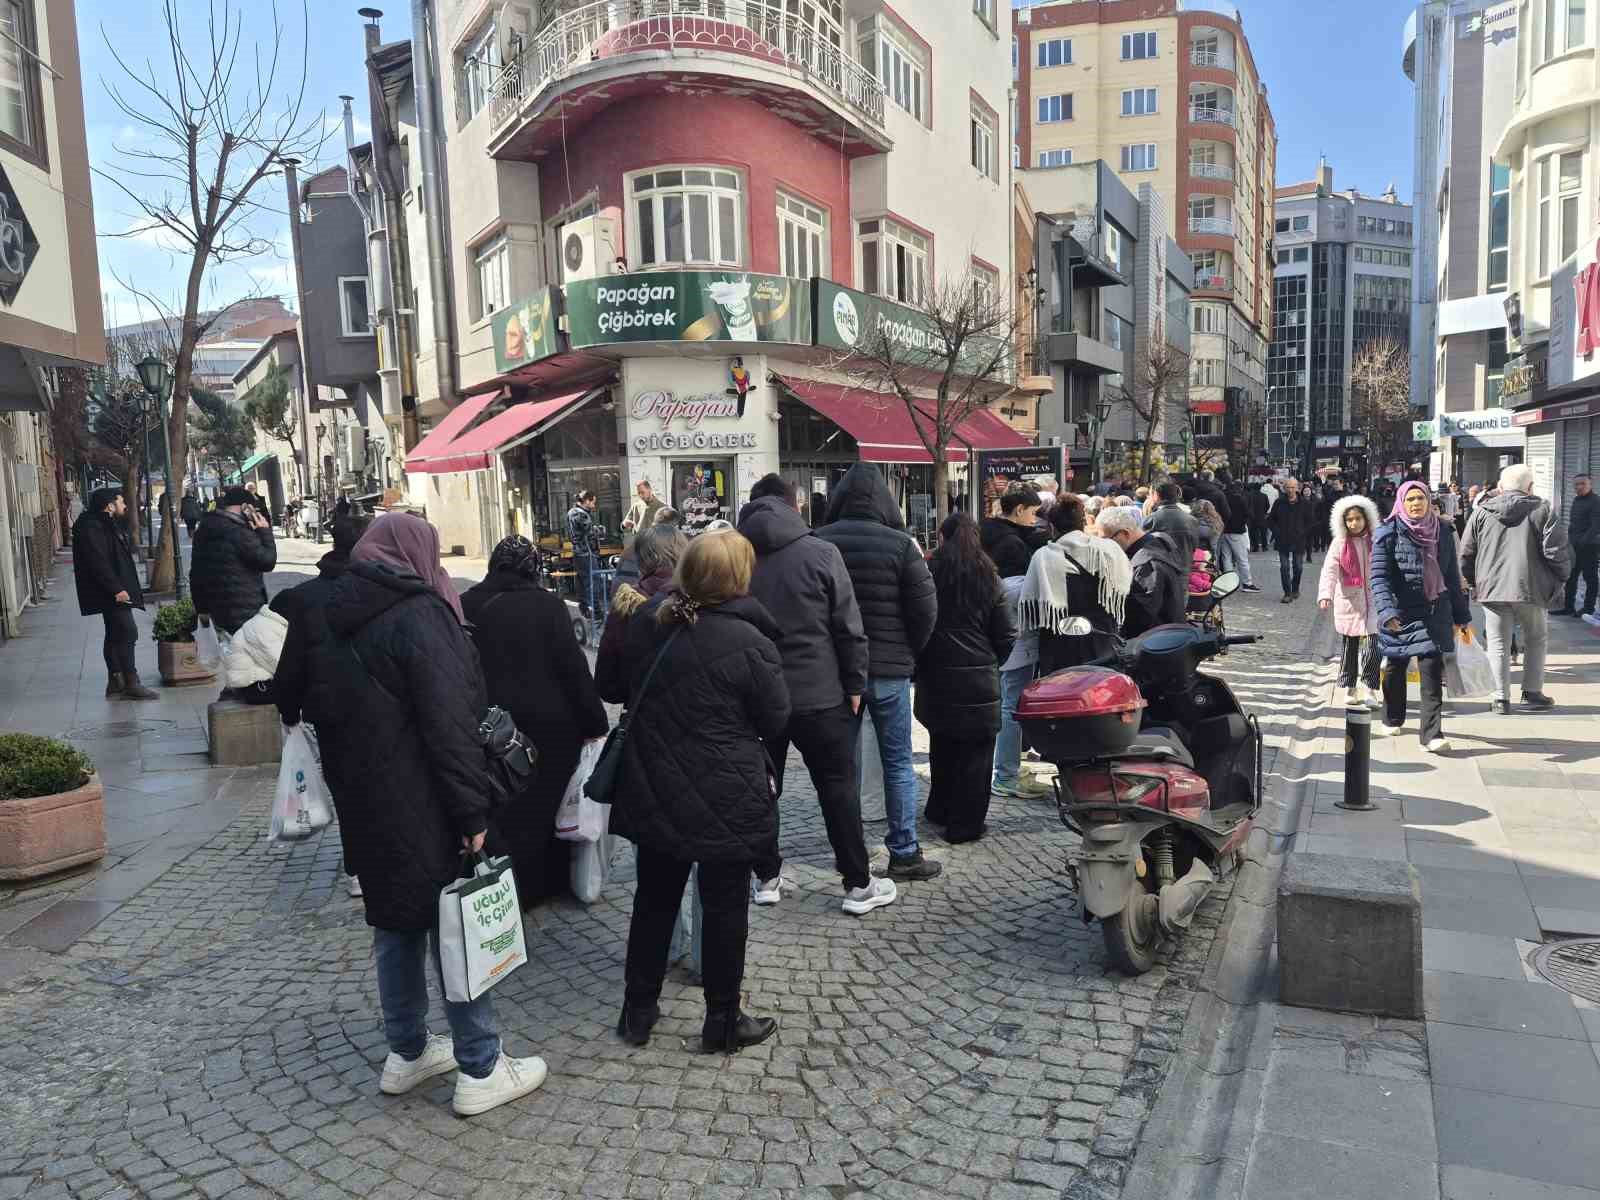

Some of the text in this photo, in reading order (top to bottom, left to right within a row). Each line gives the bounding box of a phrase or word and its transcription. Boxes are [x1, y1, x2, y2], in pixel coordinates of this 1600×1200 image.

[597, 283, 675, 307] Papağan
[598, 309, 677, 334] Çiğbörek
[1457, 416, 1498, 431] Garanti
